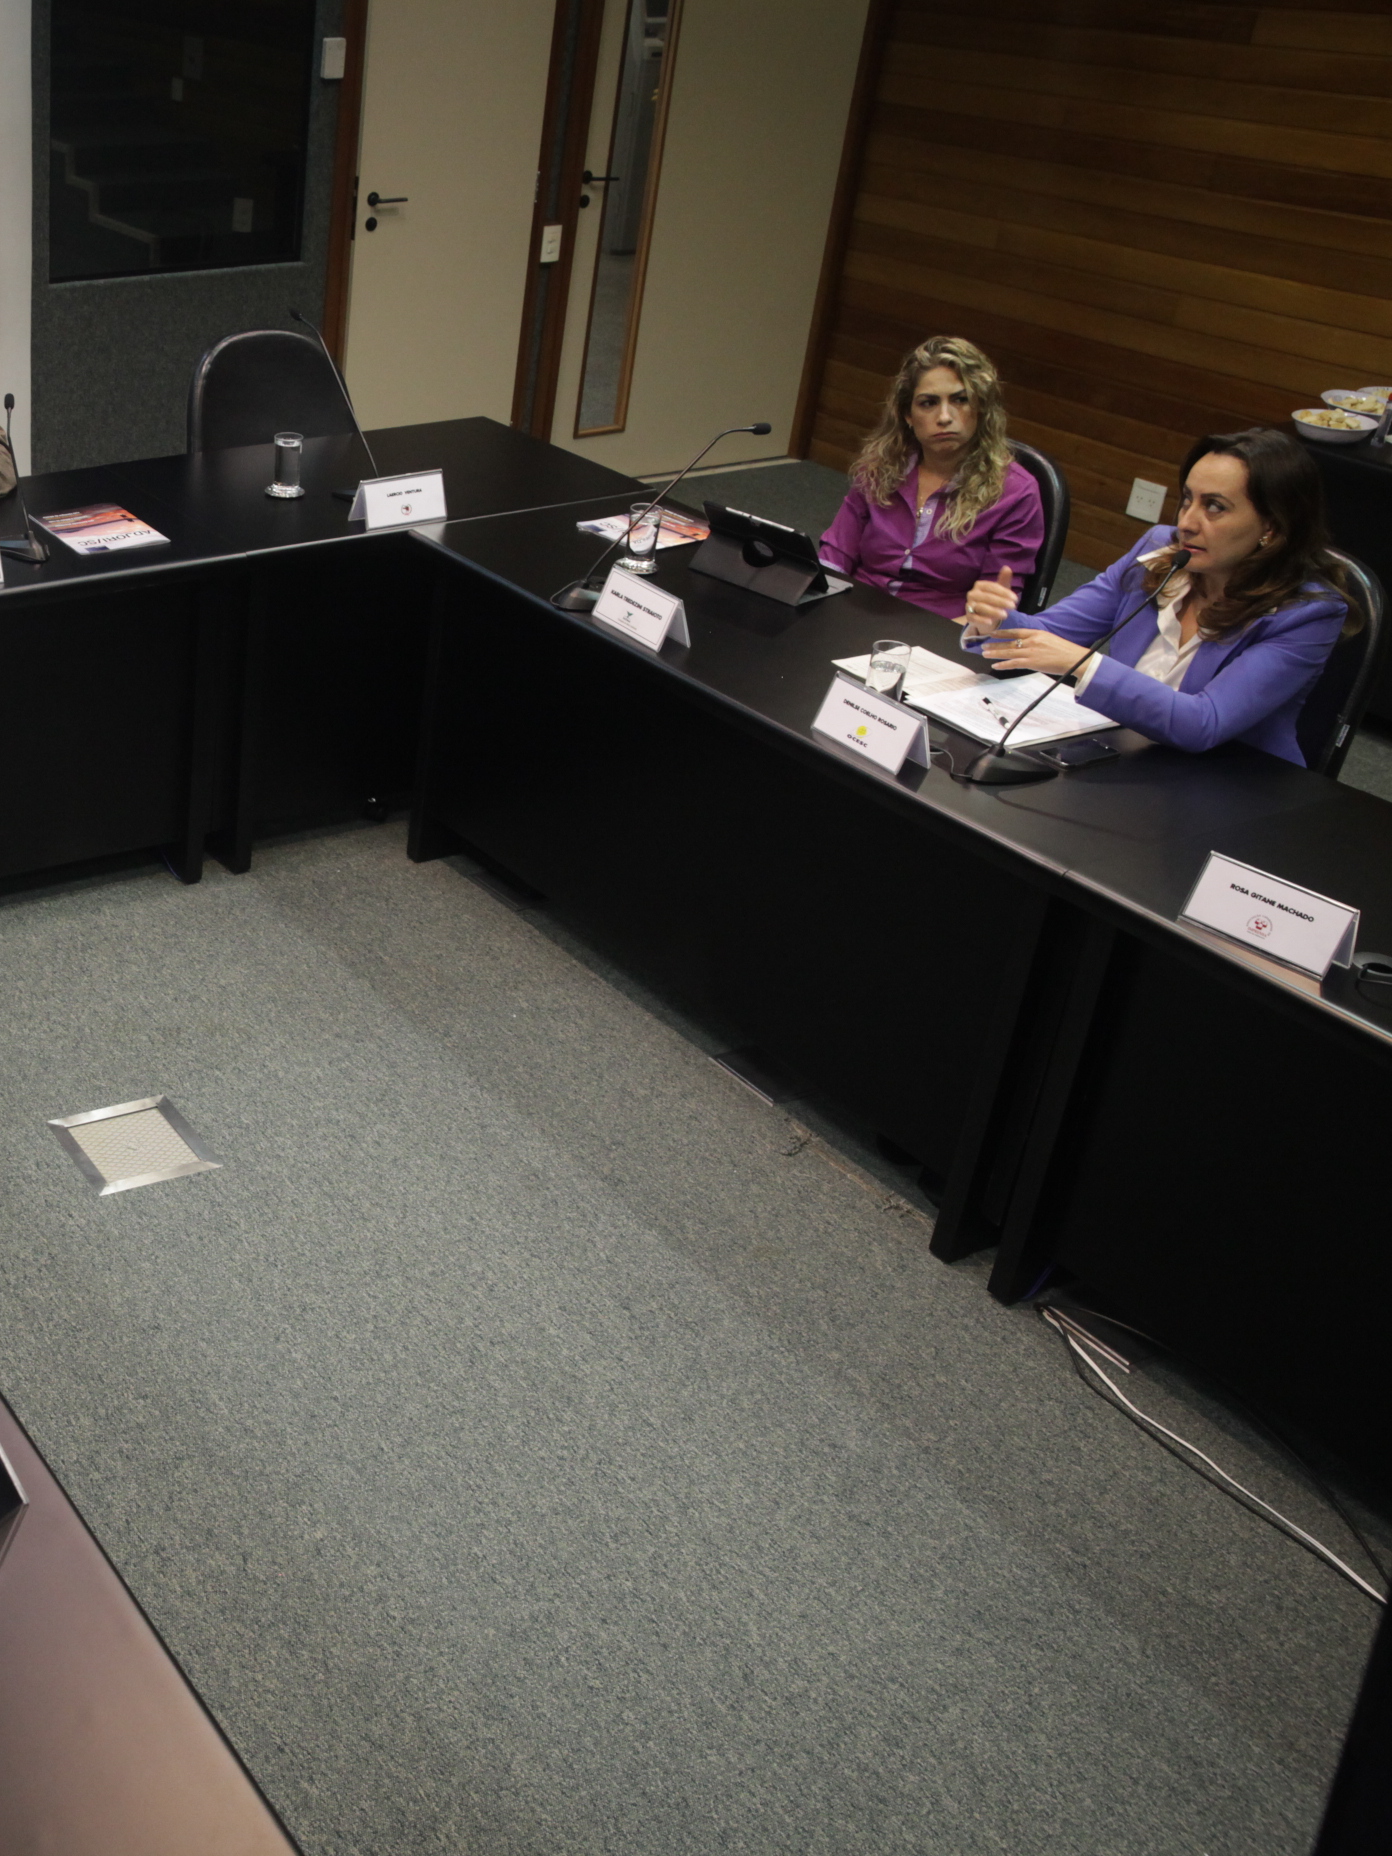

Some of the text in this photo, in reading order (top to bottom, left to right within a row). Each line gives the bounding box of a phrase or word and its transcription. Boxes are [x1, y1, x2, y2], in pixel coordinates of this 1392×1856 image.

[610, 589, 624, 600] KARLA
[860, 707, 878, 721] COELHO
[846, 733, 868, 748] OCESC
[1229, 883, 1315, 923] ROSA GITANE MACHADO
